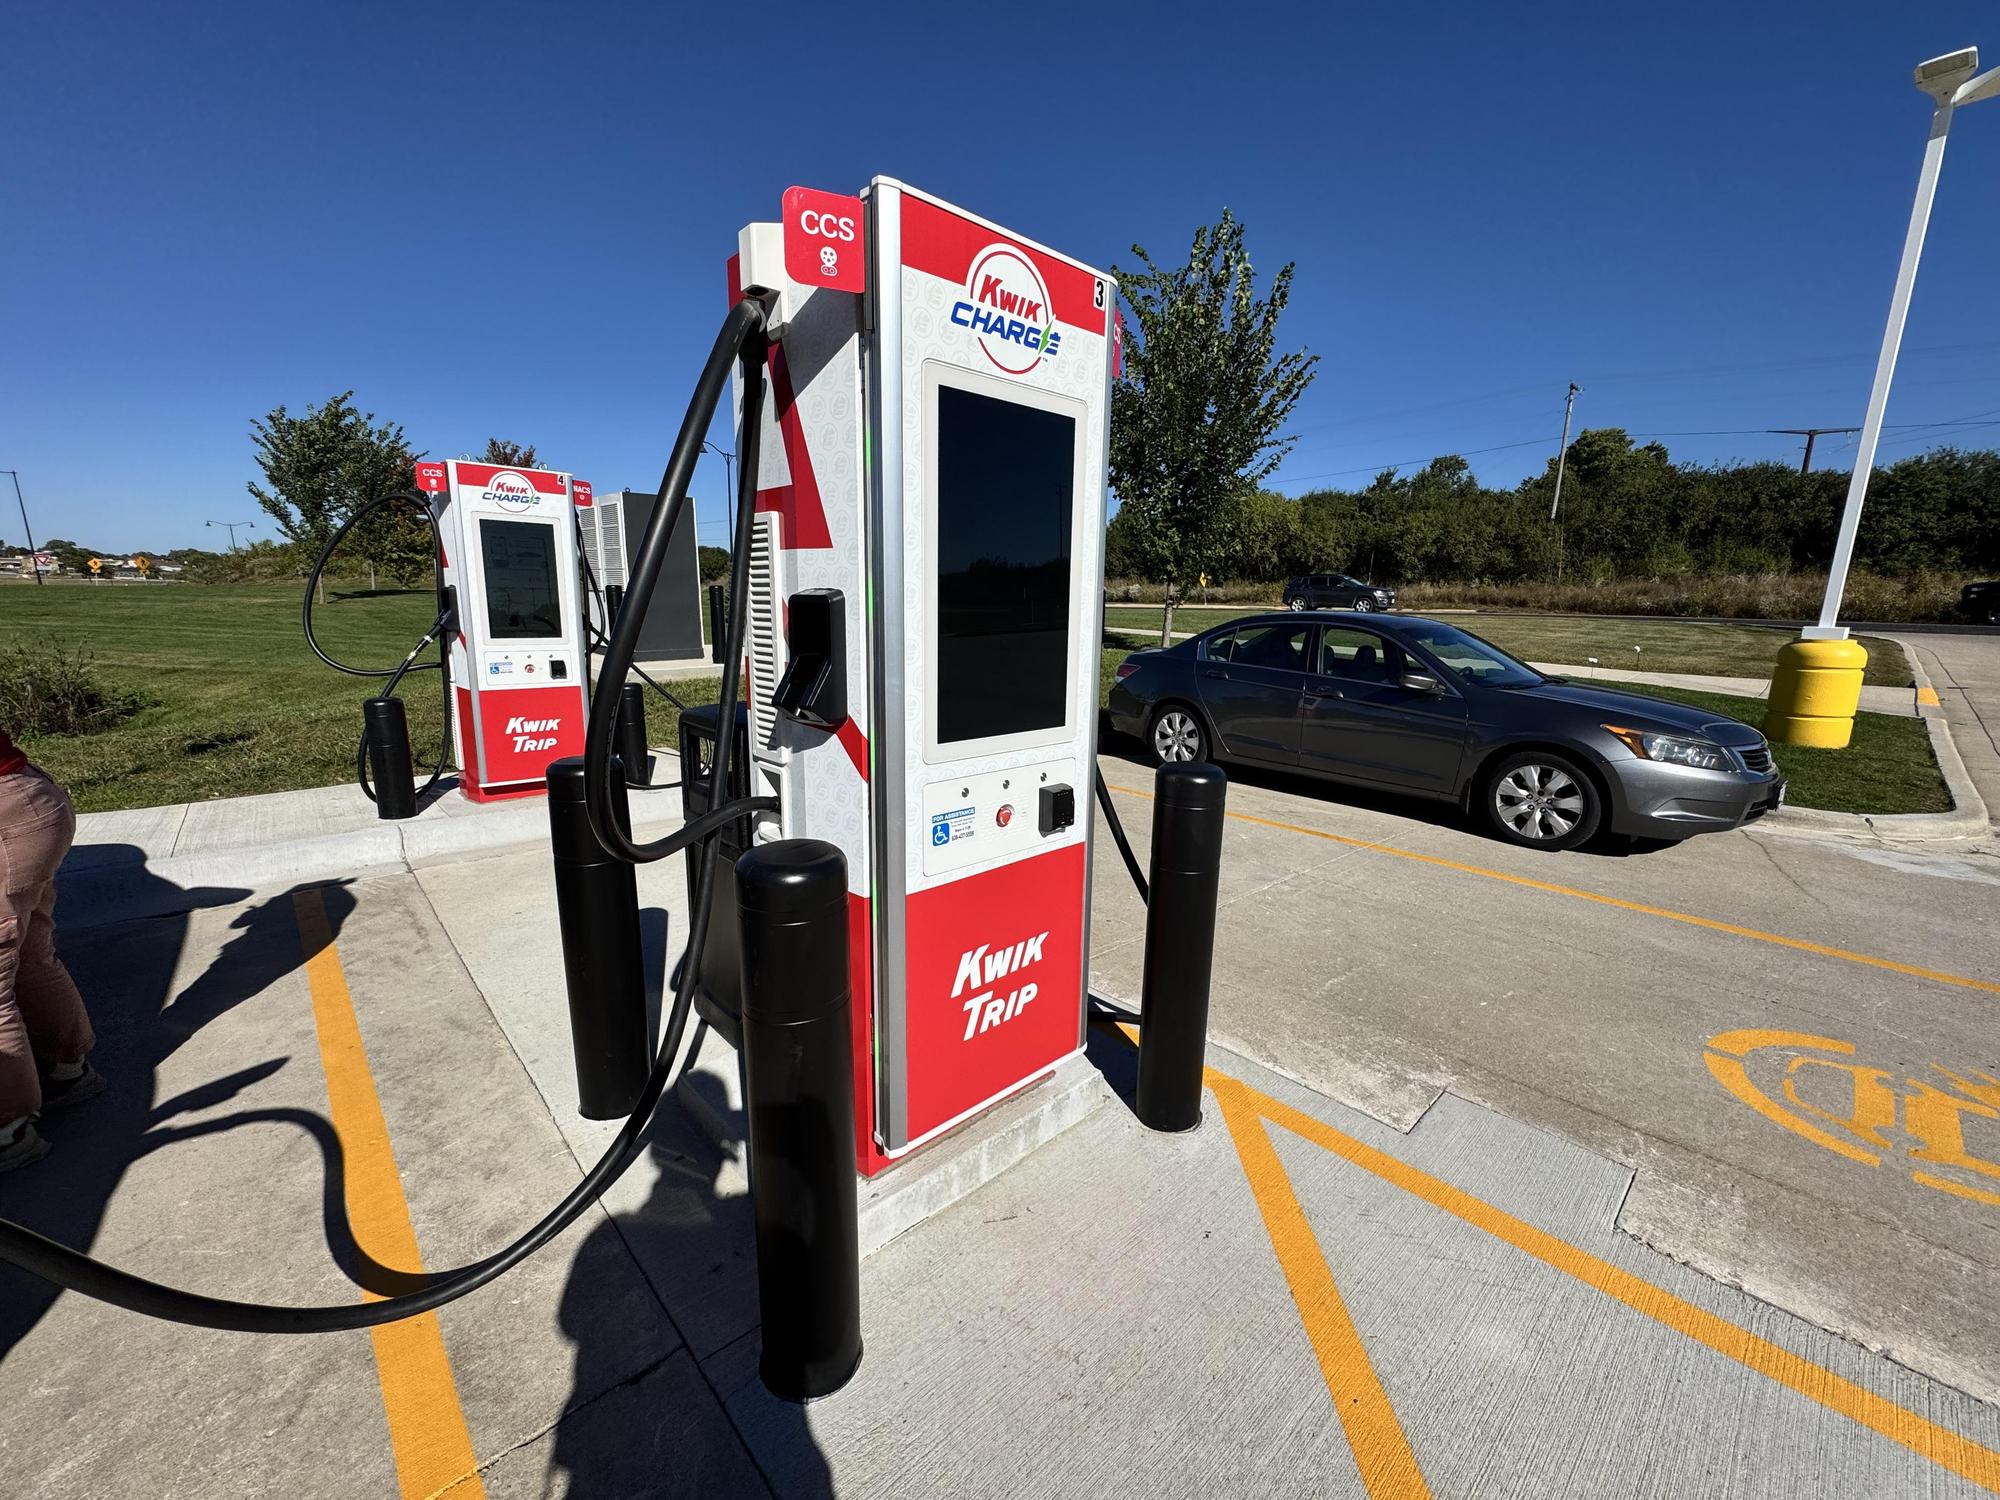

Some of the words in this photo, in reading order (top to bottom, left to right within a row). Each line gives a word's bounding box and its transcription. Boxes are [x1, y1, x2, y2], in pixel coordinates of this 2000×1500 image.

[801, 210, 855, 242] CCS
[978, 274, 1042, 323] KWIK
[1095, 280, 1104, 308] 3
[422, 468, 443, 478] CCS
[558, 475, 564, 484] 4
[495, 481, 528, 495] KWIK
[505, 716, 561, 734] KWIK
[513, 735, 558, 753] TRIP
[932, 815, 944, 823] FOR
[944, 807, 975, 820] ASSISTANCE
[950, 931, 1049, 999] KWIK
[963, 982, 1038, 1041] TRIP
